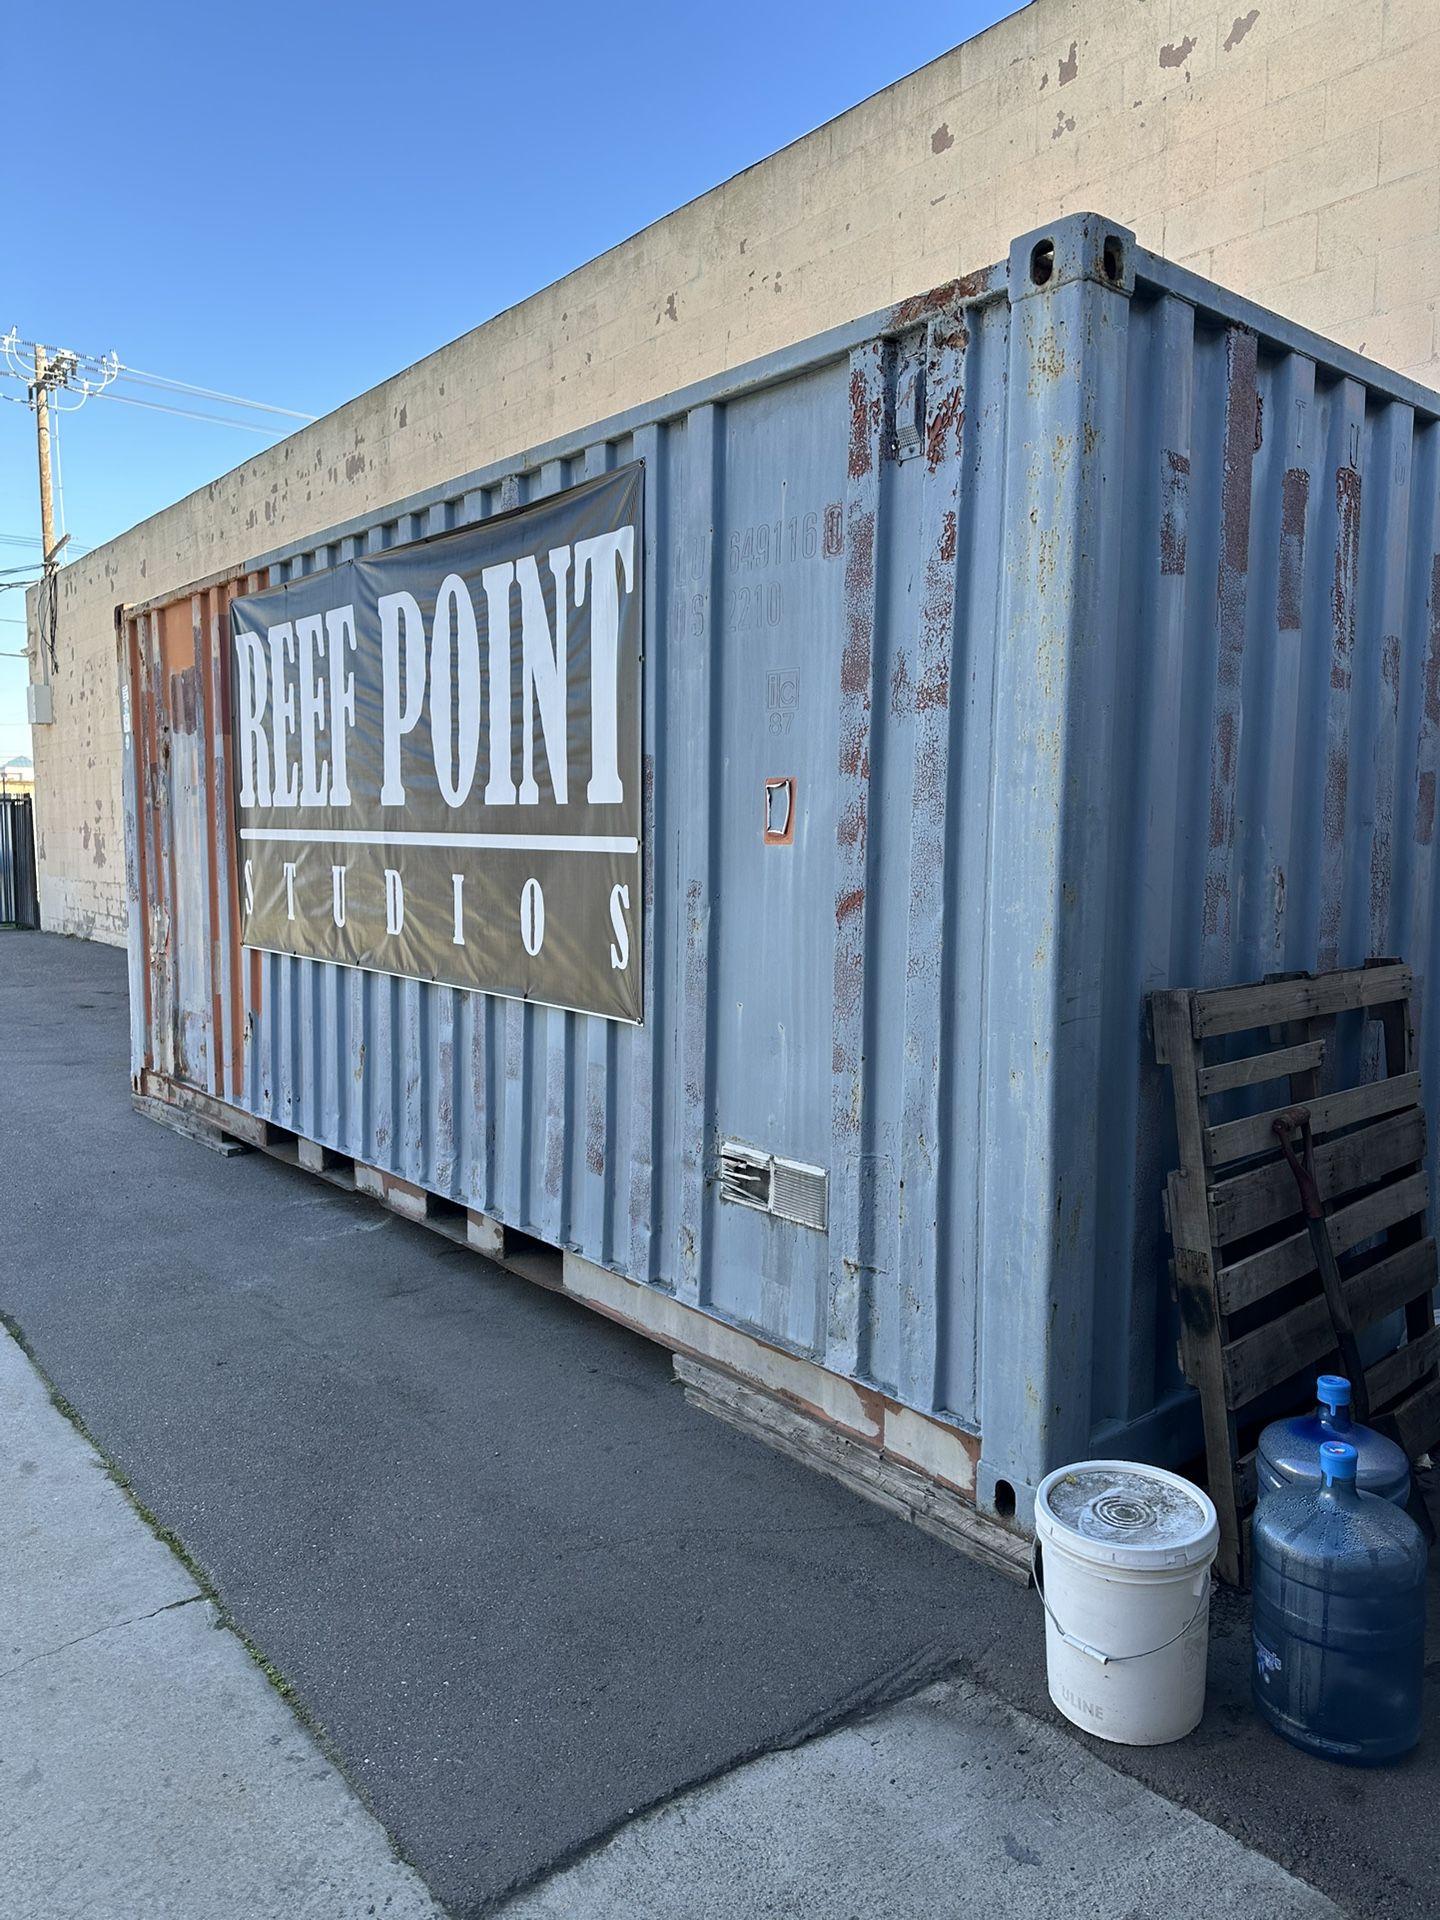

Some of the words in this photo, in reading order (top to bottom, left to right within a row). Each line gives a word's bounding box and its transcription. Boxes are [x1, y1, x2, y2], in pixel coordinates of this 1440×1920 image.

[234, 603, 359, 808] REEF
[377, 525, 635, 808] POINT
[243, 858, 631, 971] STUDIOS
[1061, 1684, 1104, 1721] ULINE
